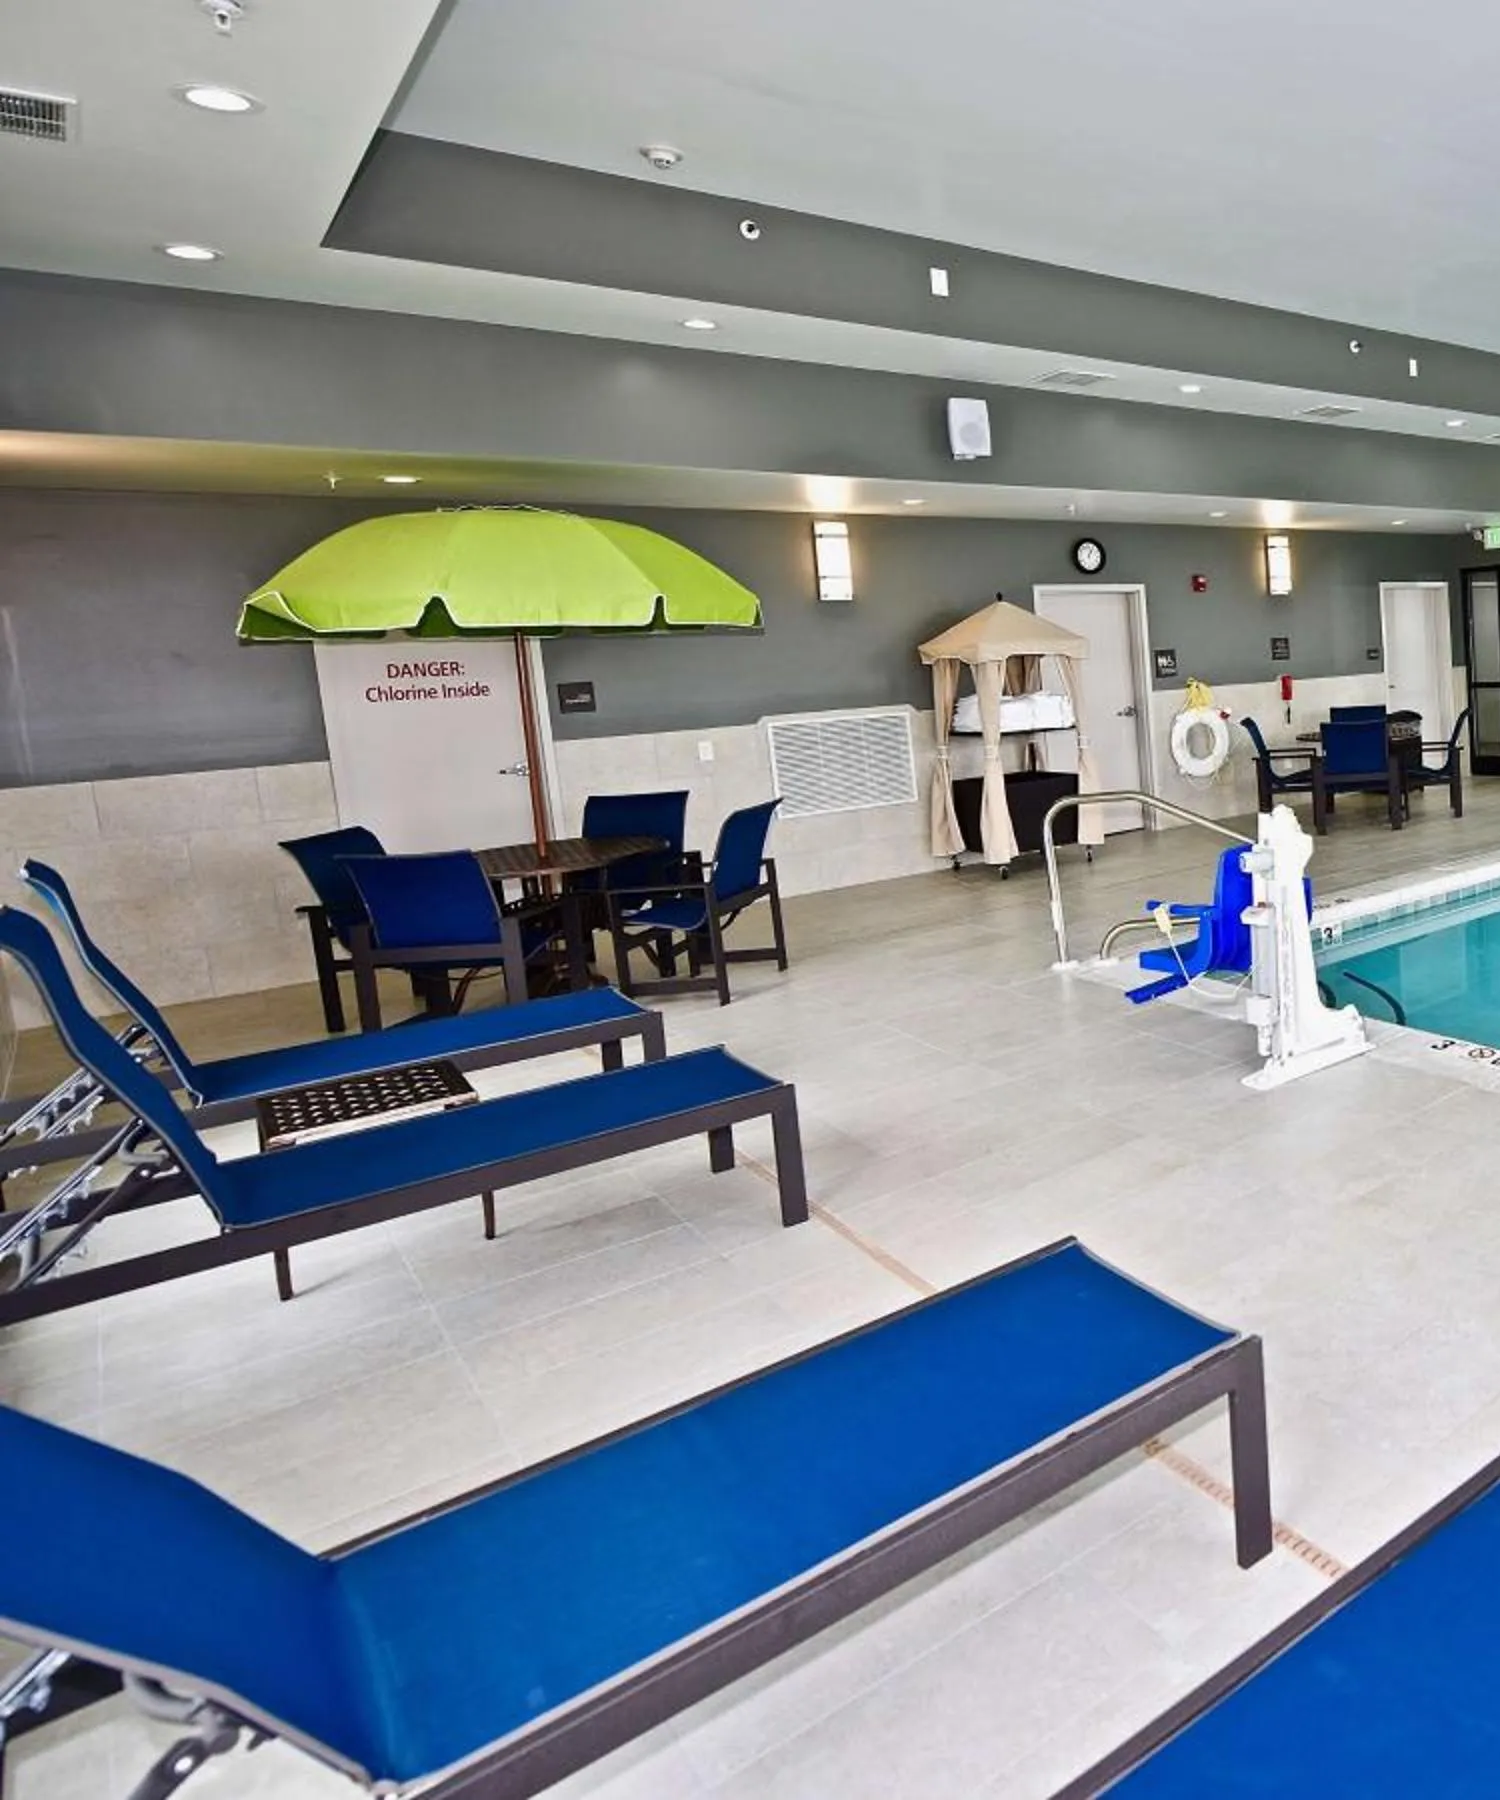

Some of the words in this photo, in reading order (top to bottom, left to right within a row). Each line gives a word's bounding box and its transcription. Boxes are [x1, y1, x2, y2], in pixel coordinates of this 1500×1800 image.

[386, 661, 466, 679] DANGER:
[365, 683, 438, 703] Chlorine
[441, 681, 490, 699] Inside
